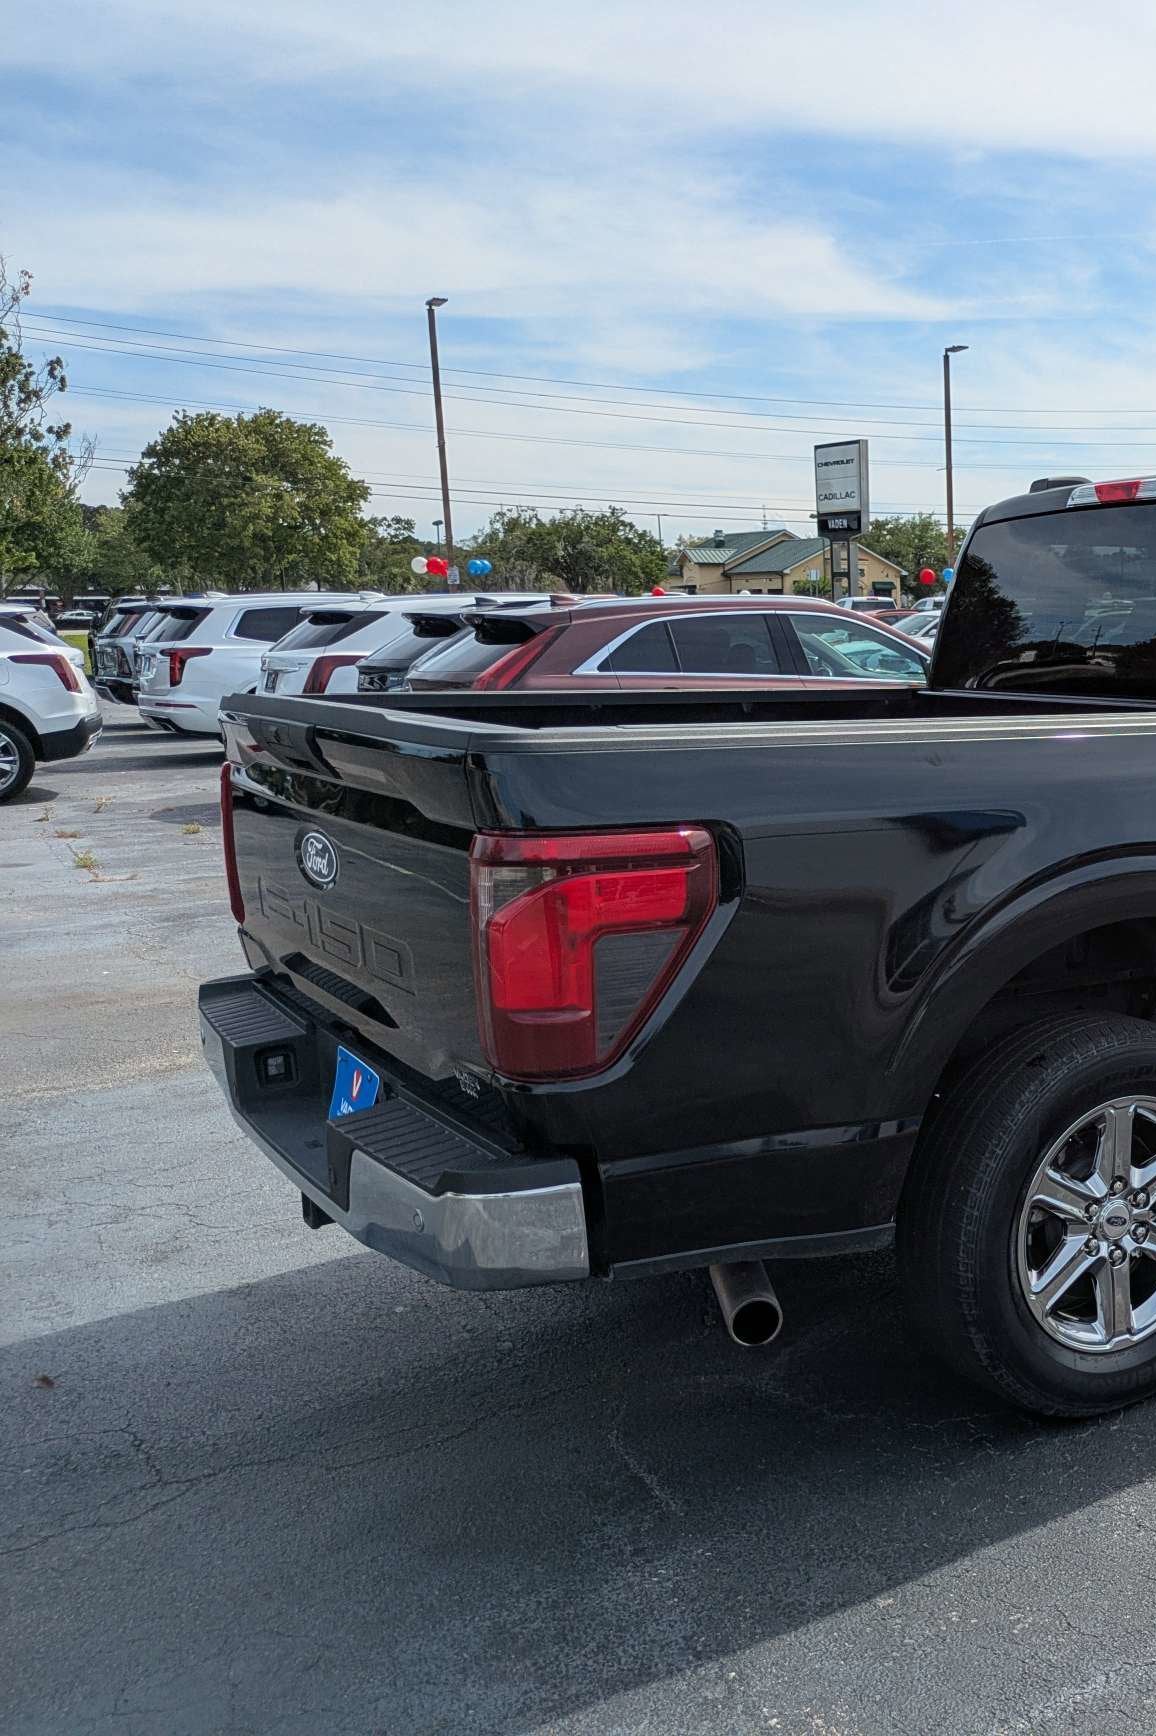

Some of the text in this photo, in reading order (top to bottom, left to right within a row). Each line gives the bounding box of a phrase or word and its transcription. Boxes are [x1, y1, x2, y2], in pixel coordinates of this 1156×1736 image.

[817, 458, 855, 468] CHEVROLET
[818, 491, 856, 501] CADILLAC
[827, 519, 848, 529] VADEN
[306, 838, 330, 876] Ford
